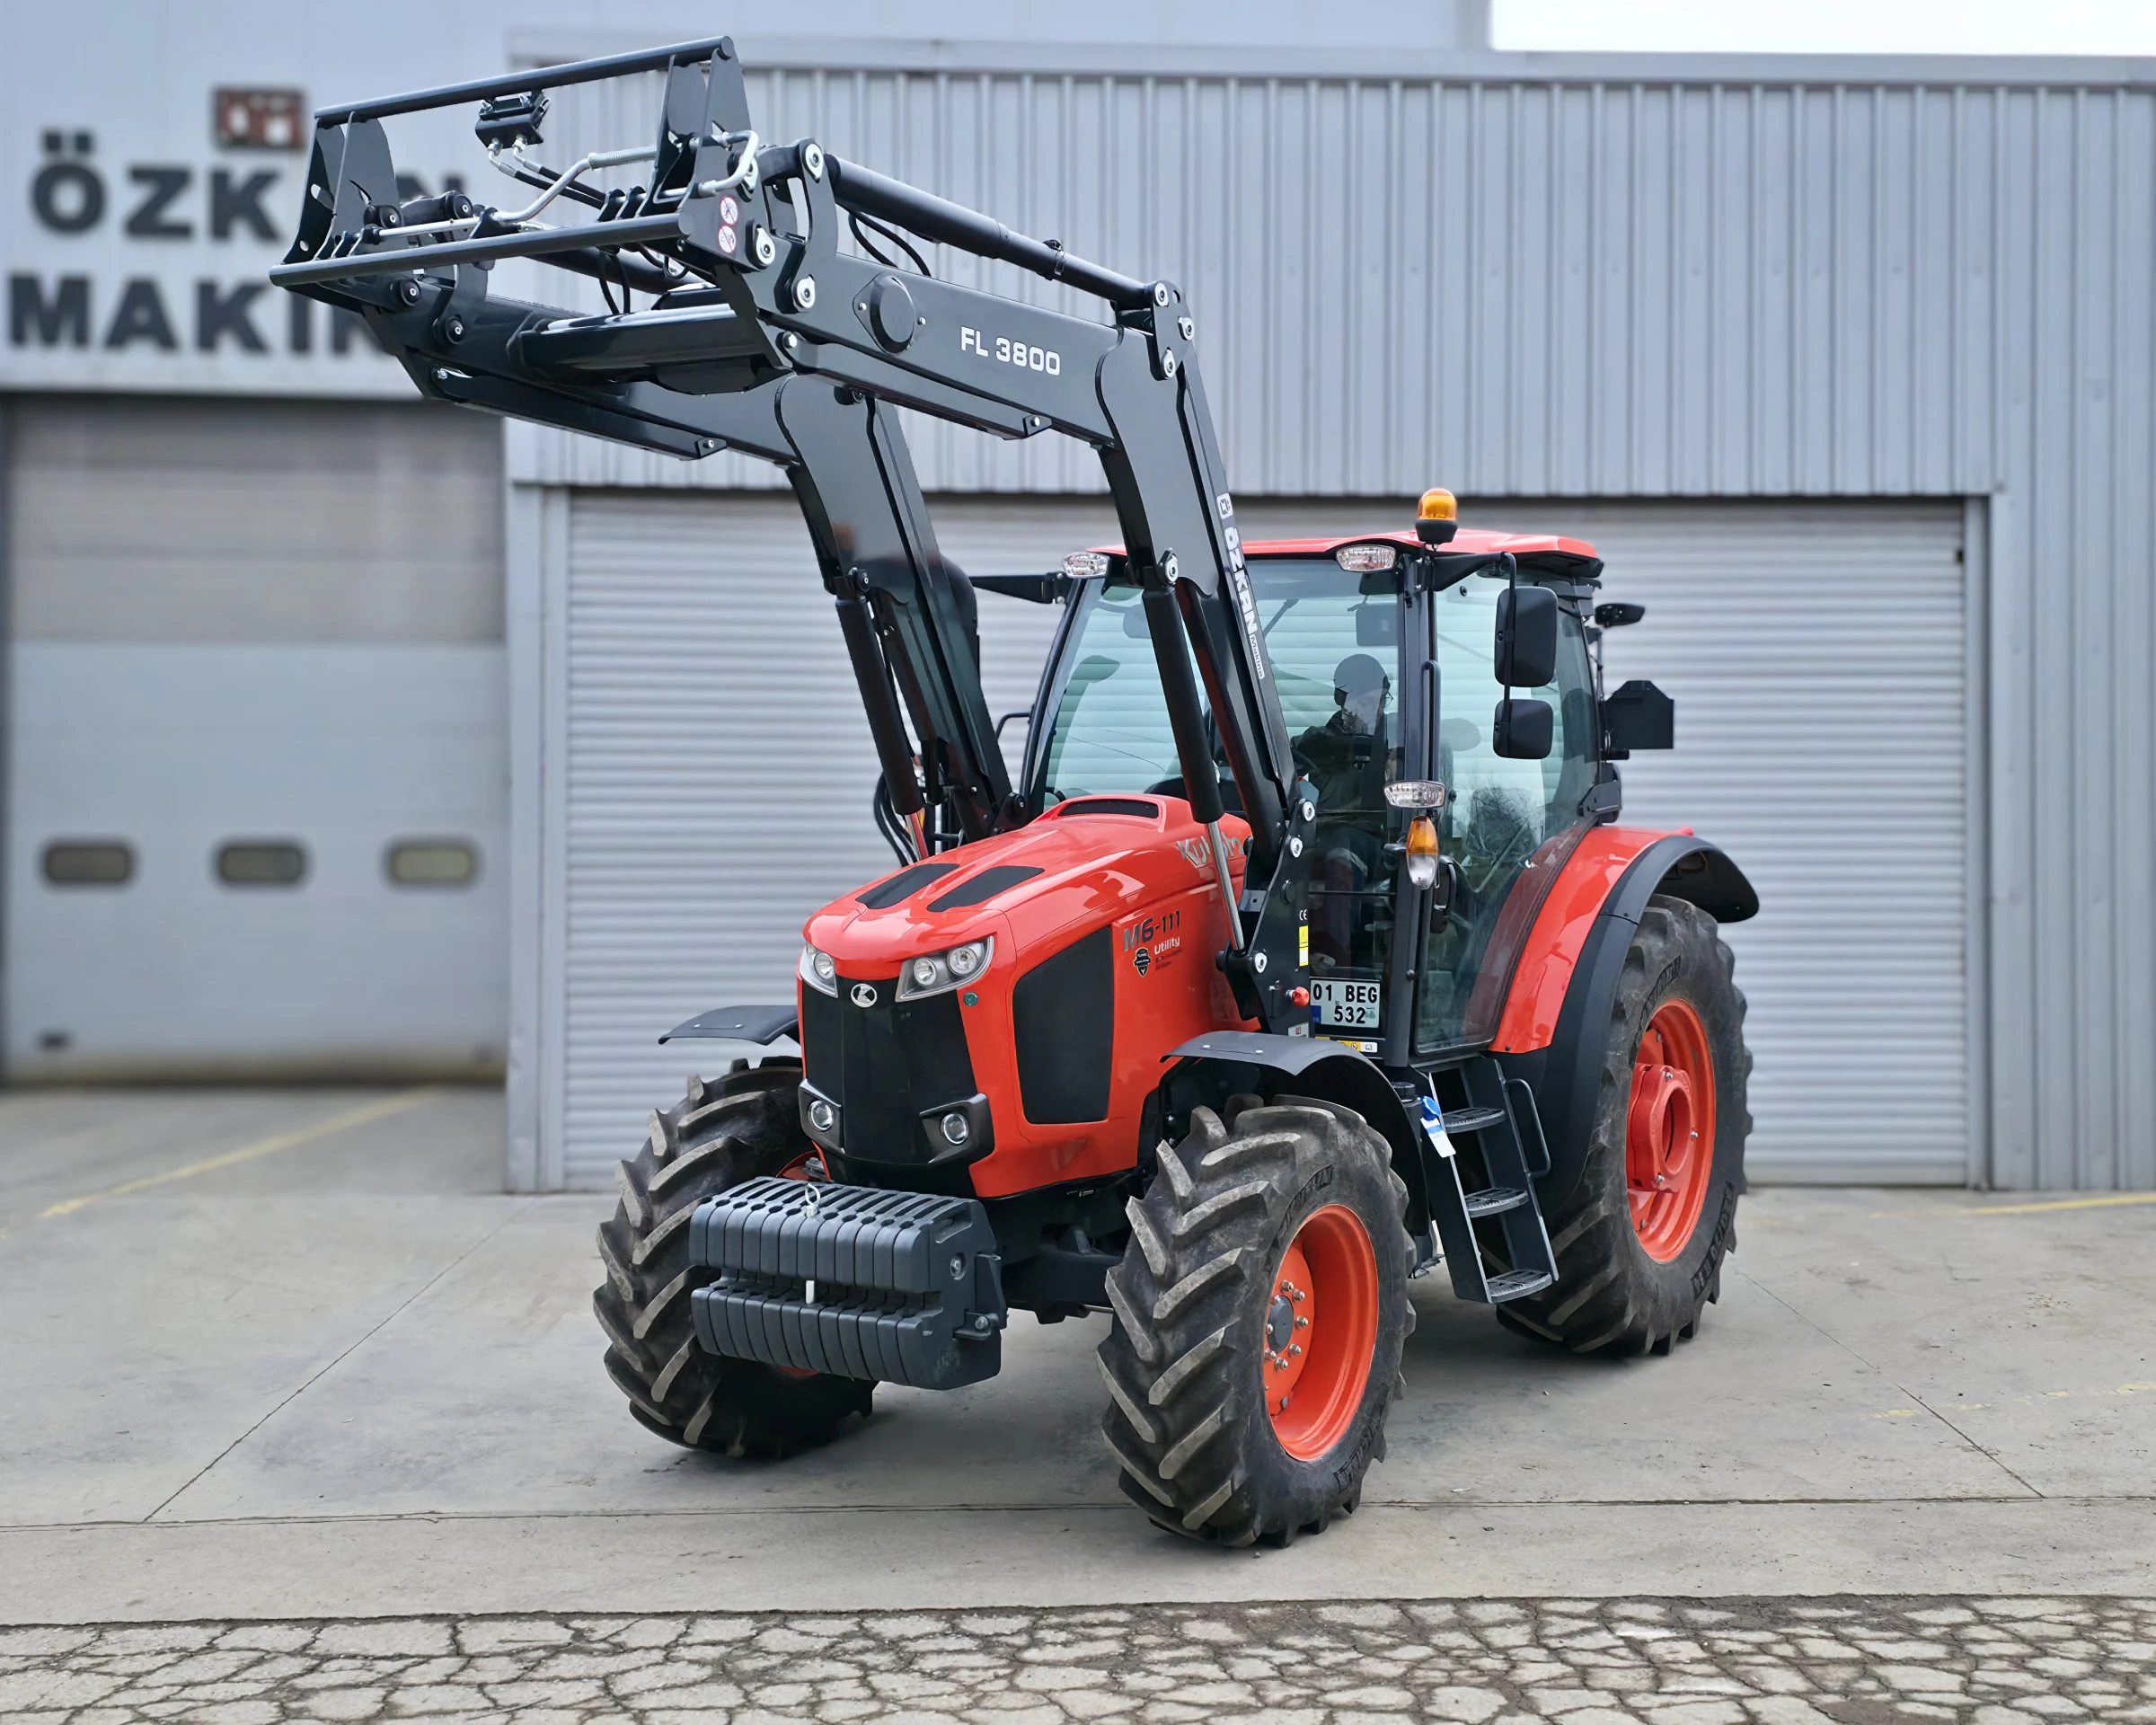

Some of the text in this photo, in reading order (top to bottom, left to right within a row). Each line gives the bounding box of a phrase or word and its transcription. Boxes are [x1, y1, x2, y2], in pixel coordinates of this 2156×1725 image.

[960, 326, 1060, 376] FL 3800
[1123, 909, 1180, 952] M6-111
[1153, 936, 1180, 955] Utility
[1312, 983, 1377, 1004] 01 BEG
[1334, 1005, 1365, 1024] 532
